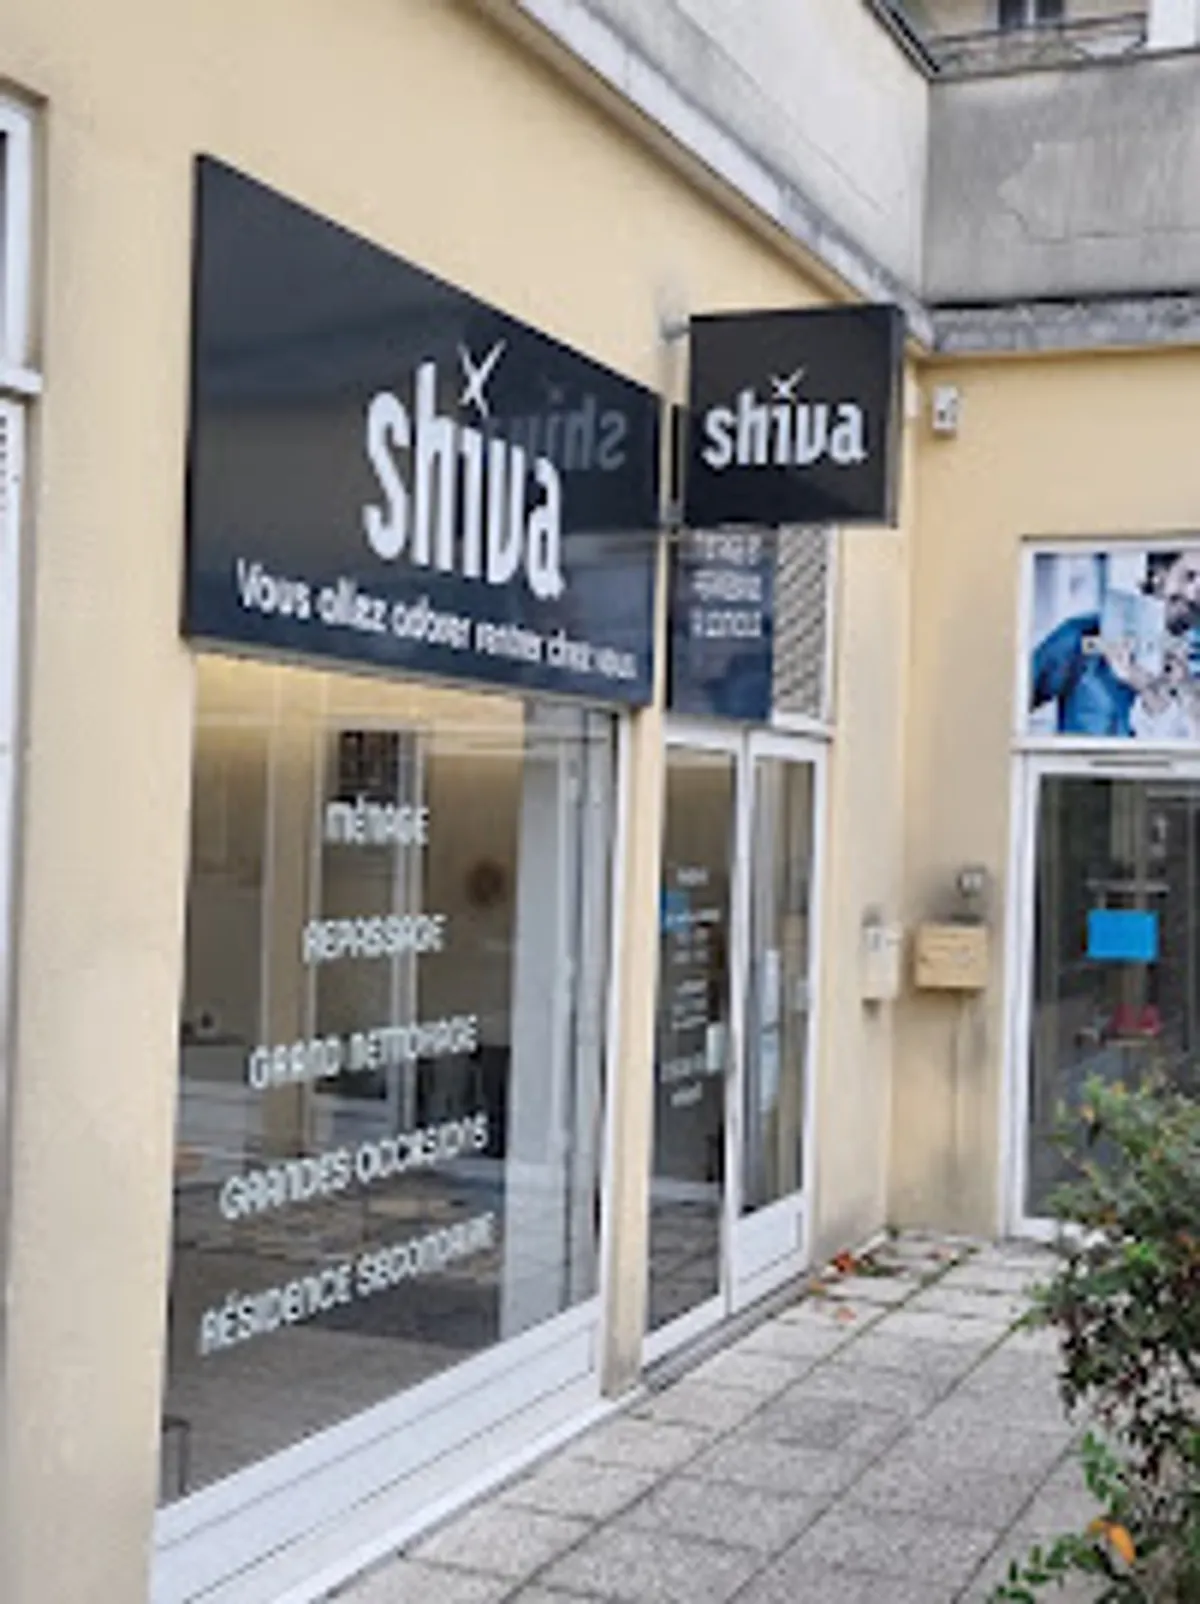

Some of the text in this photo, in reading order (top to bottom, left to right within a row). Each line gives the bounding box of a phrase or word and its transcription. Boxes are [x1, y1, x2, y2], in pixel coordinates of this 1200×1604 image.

[702, 366, 868, 468] shiva
[363, 340, 565, 600] shiva
[236, 557, 310, 620] Vous
